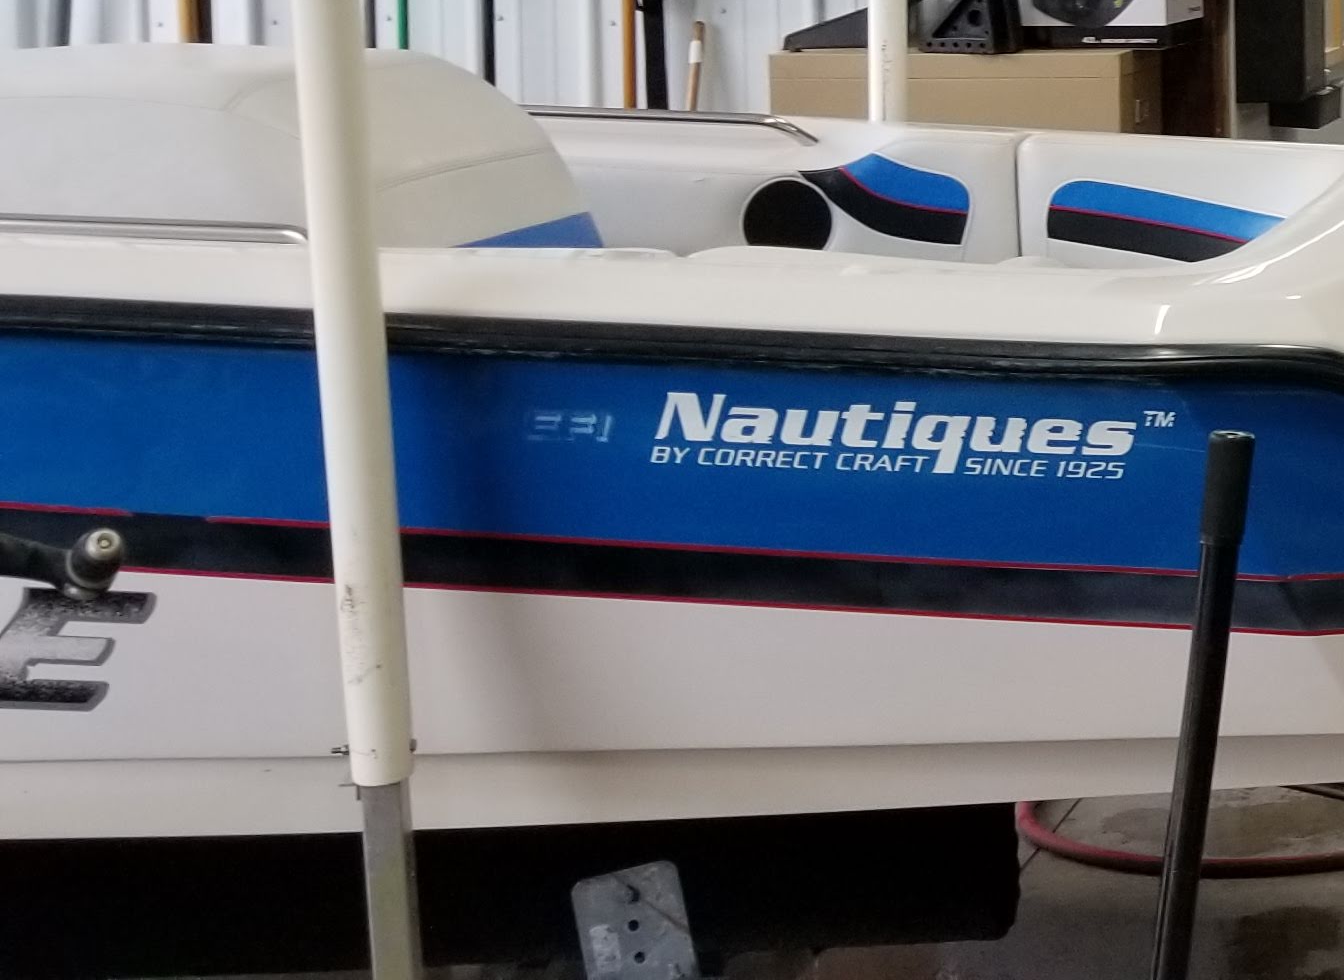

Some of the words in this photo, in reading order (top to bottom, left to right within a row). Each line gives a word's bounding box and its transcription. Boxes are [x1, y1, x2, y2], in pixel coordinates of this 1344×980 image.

[654, 391, 1137, 474] Nautiques
[650, 445, 691, 464] BY
[697, 447, 829, 470] CORRECT
[835, 452, 931, 473] CRAFT
[963, 457, 1049, 478] SINCE
[1055, 460, 1127, 480] 1925
